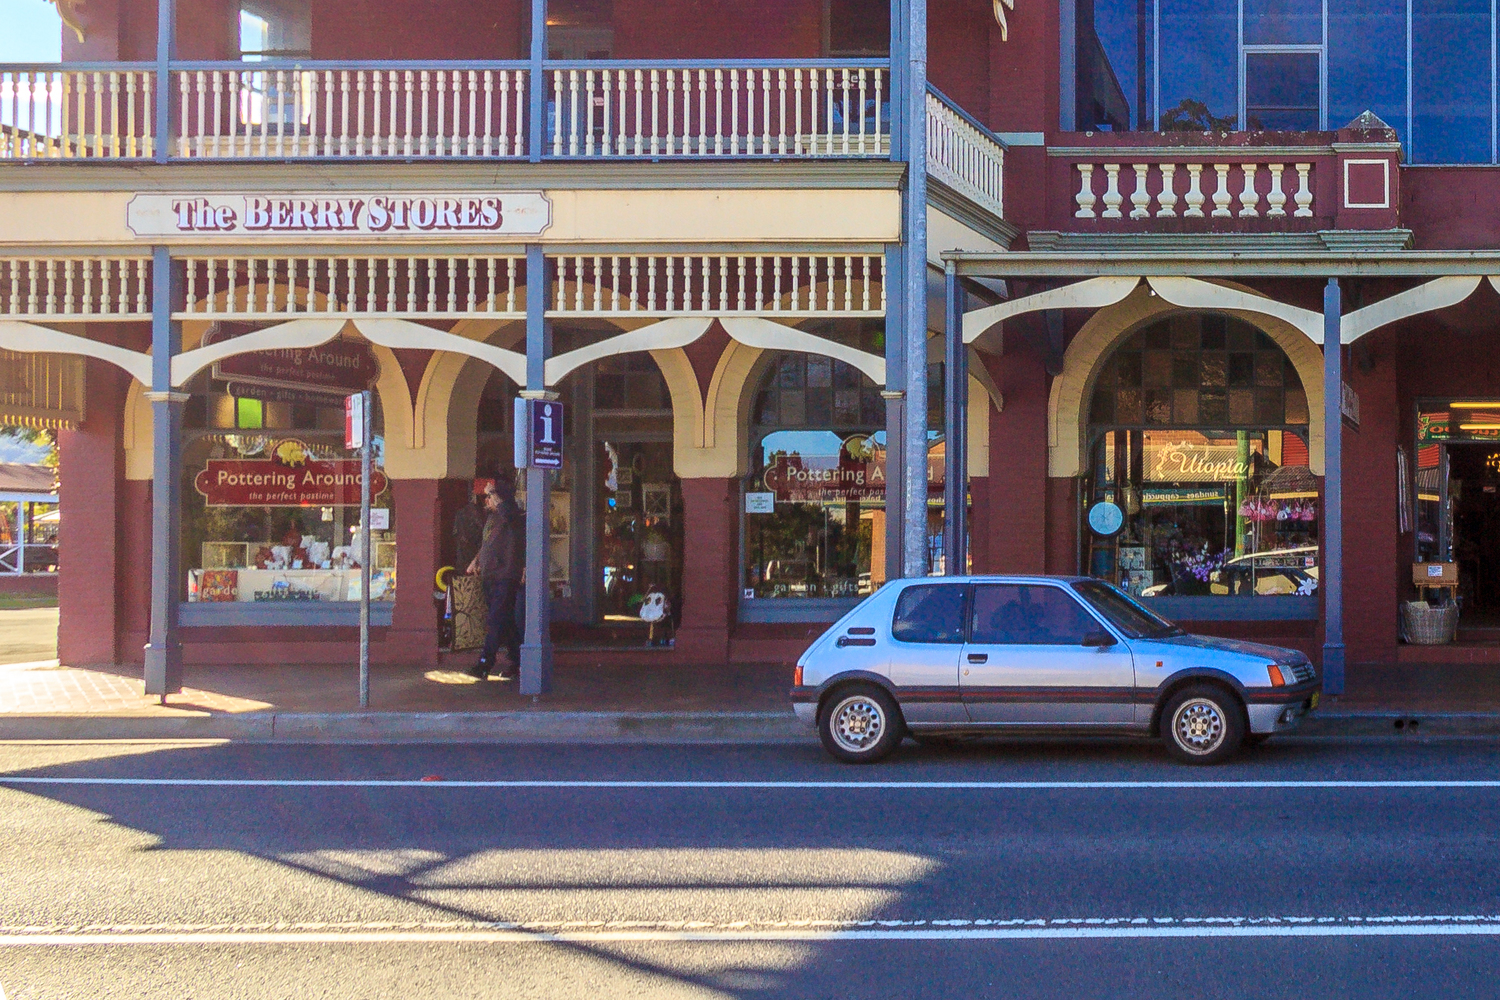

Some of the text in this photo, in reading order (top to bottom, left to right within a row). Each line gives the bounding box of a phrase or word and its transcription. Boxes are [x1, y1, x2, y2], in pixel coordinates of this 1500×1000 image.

[172, 196, 503, 231] The BERRY STORES
[308, 349, 360, 369] Around
[218, 470, 296, 490] Pottering
[786, 466, 865, 484] Pottering
[249, 491, 334, 503] the perfect pastime
